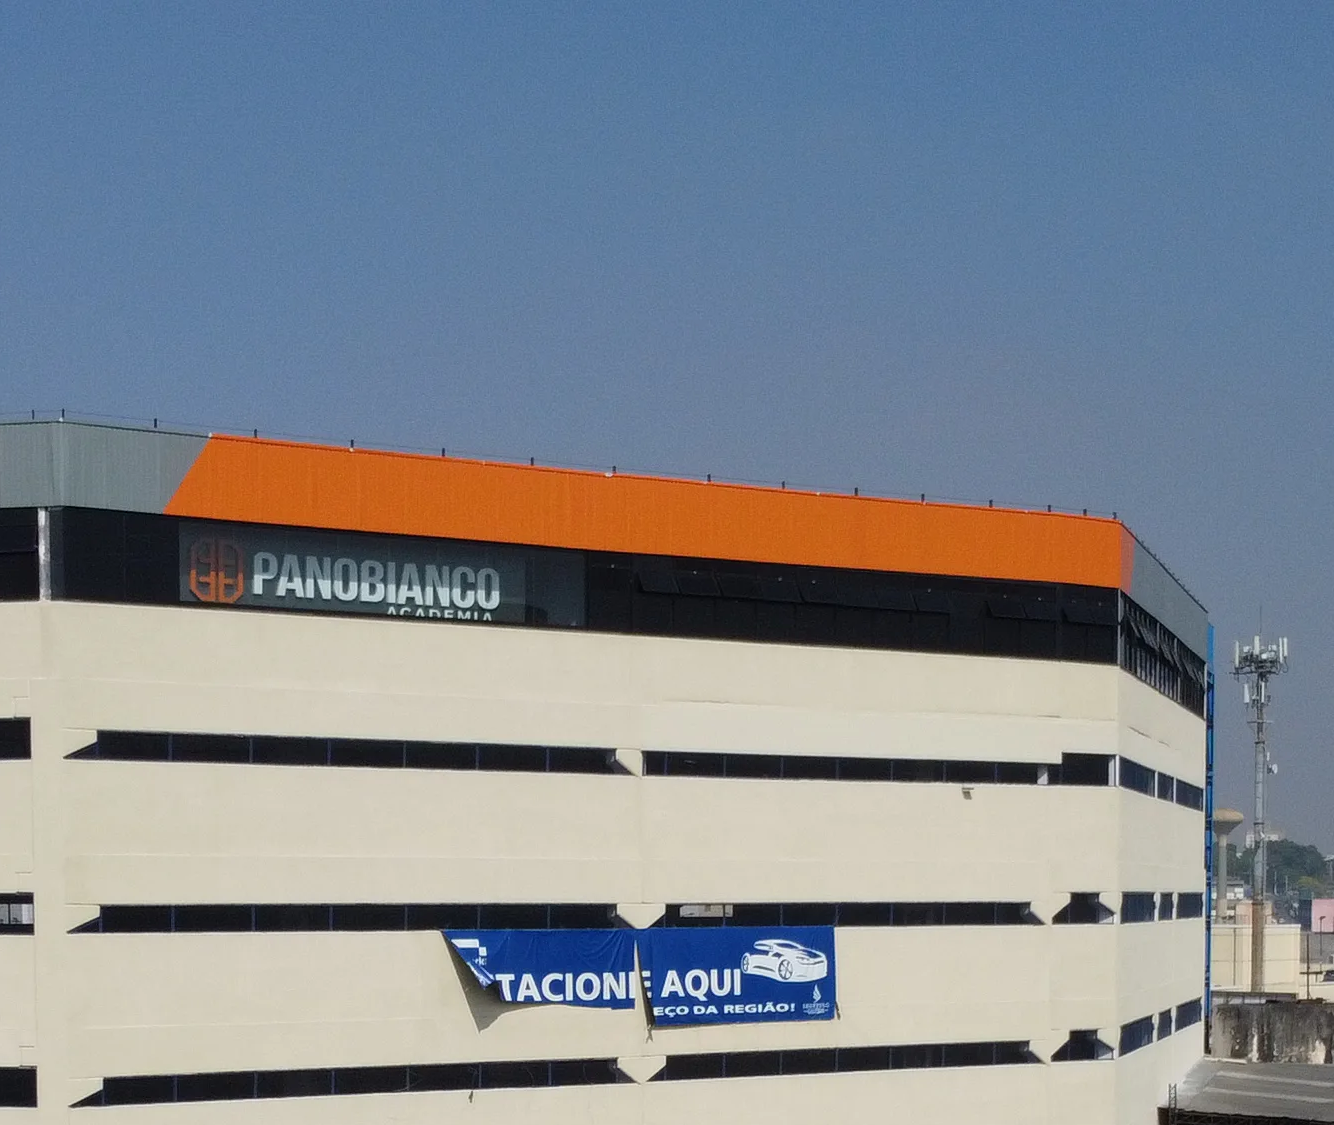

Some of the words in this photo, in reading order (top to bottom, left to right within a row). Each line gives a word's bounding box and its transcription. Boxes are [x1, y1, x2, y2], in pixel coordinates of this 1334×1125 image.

[252, 551, 500, 610] PANOBIANCO
[386, 606, 493, 621] ACADEMIA
[661, 971, 742, 1002] AQUI
[692, 1004, 717, 1016] DA
[718, 1001, 796, 1015] REGIÃO!
